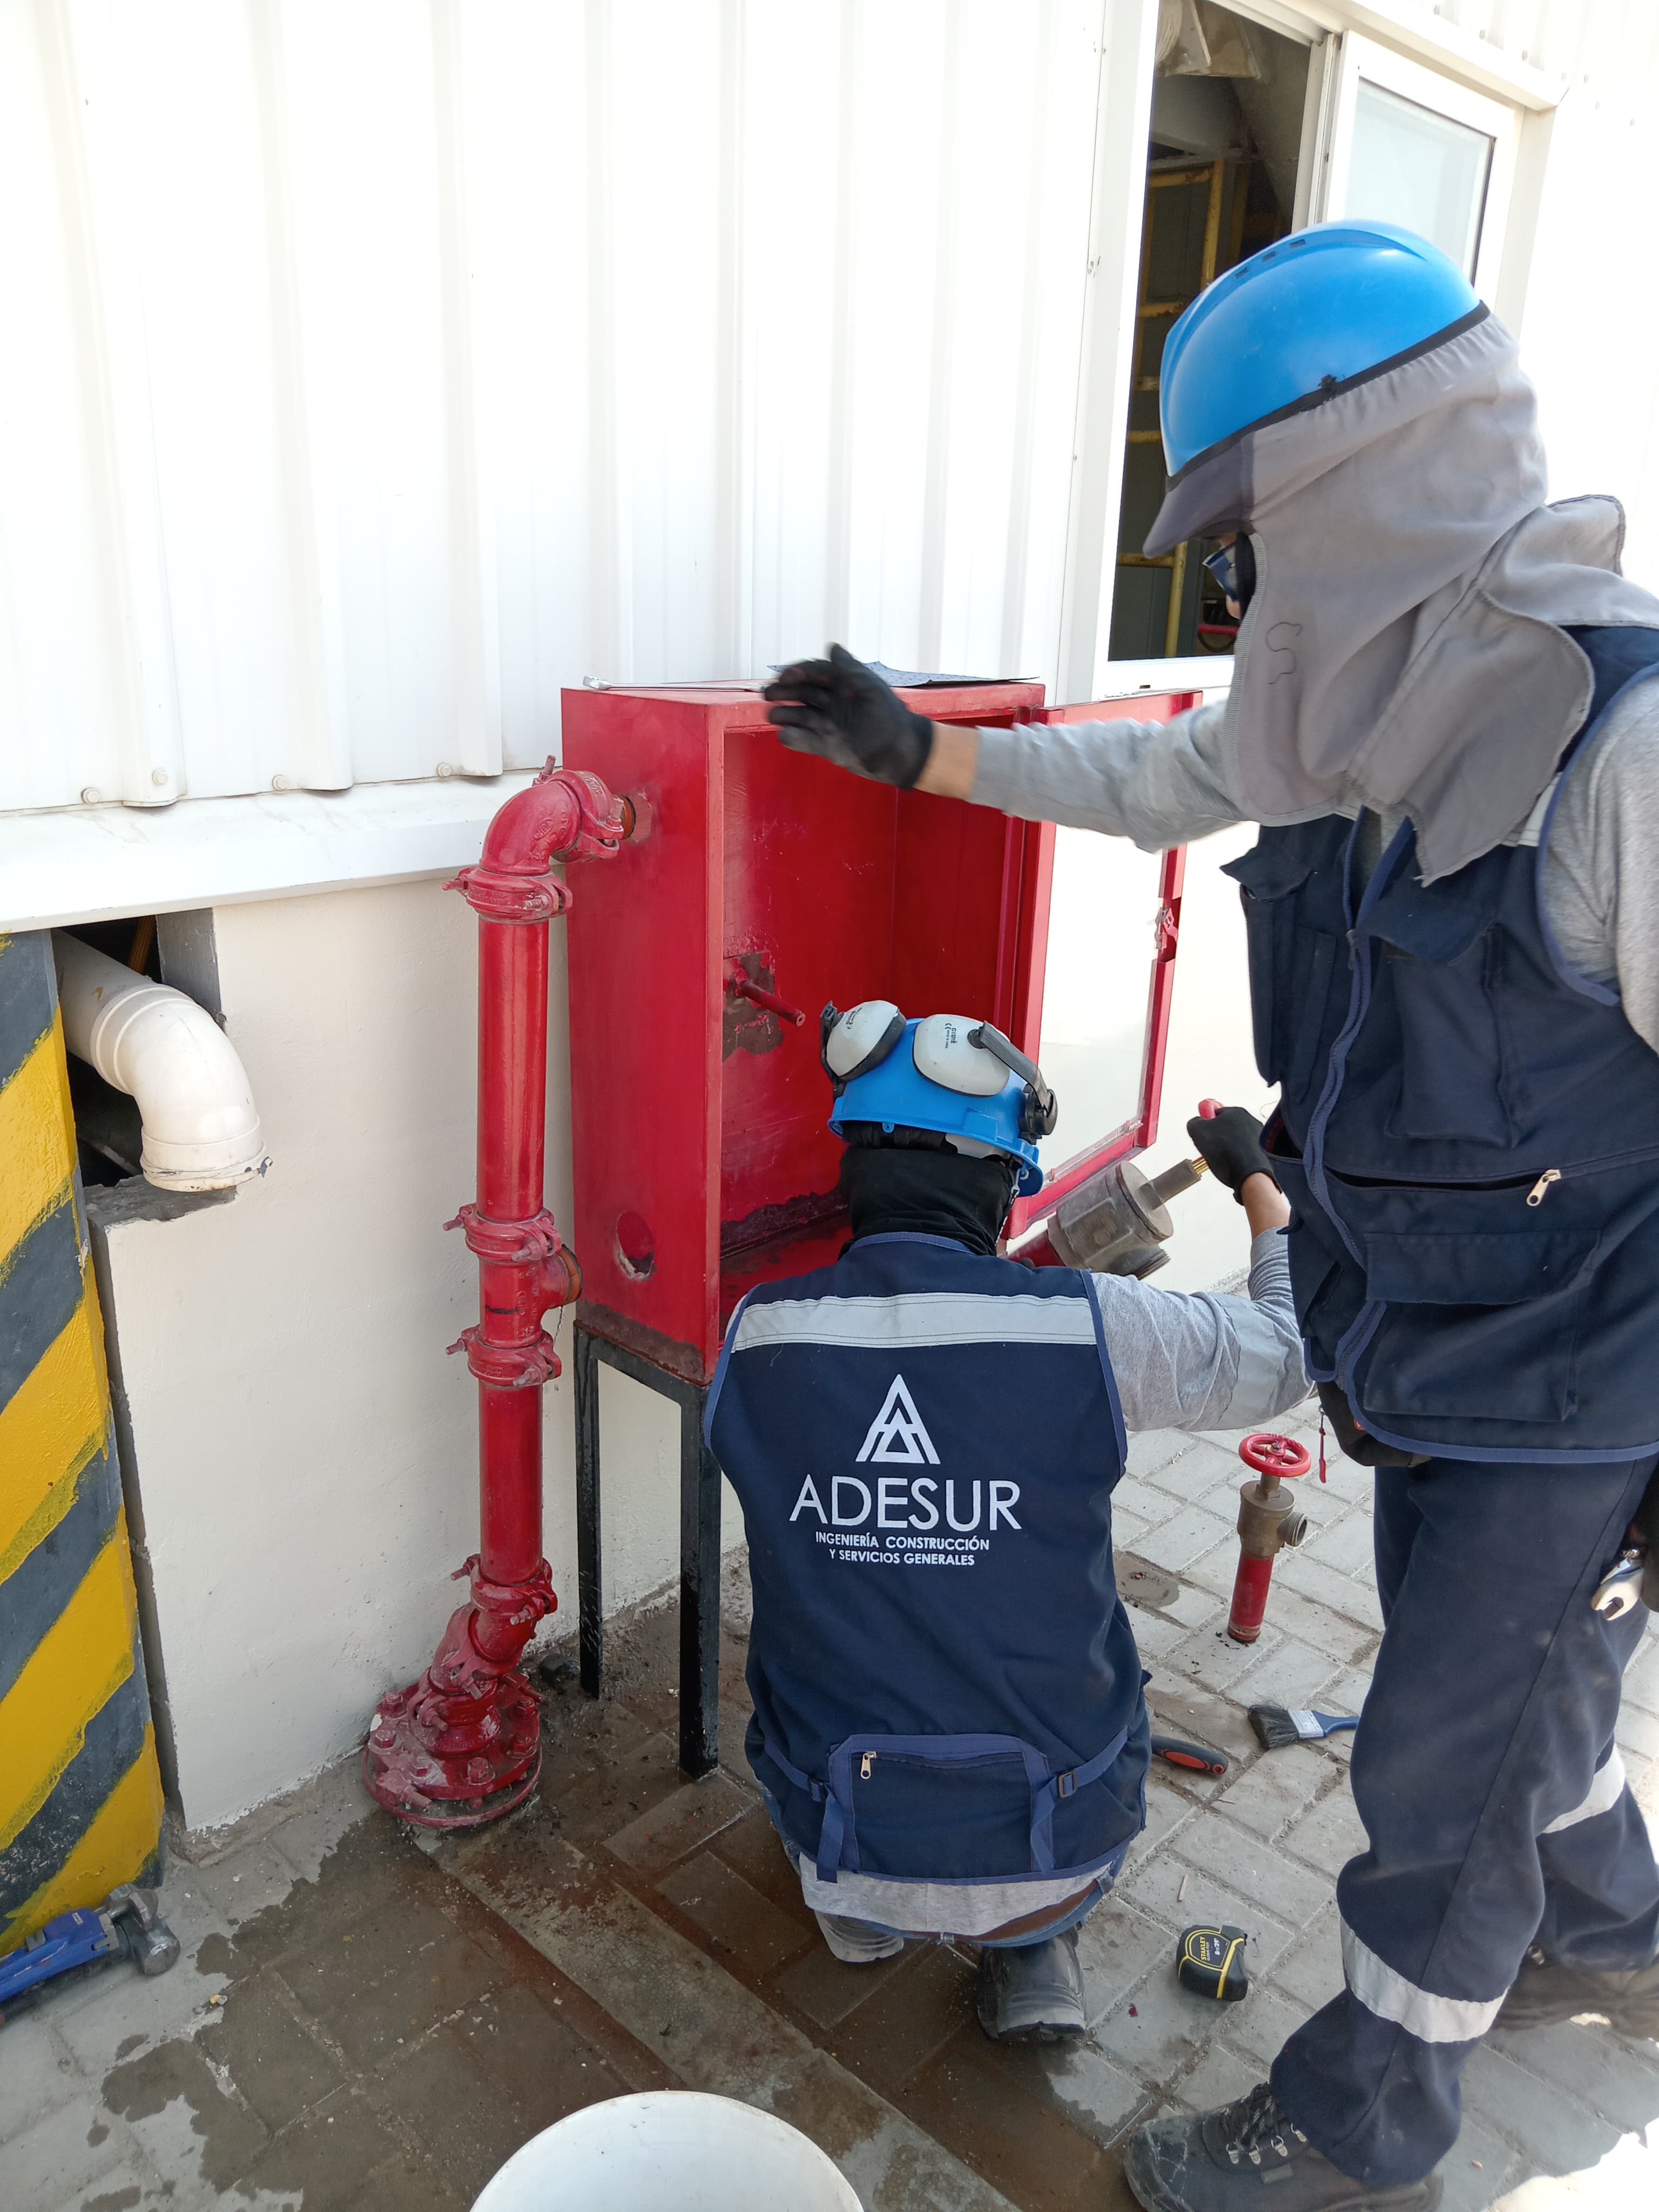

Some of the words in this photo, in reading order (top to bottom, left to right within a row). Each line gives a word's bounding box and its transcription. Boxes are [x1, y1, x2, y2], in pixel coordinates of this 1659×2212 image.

[789, 1474, 1022, 1532] ADESUR
[815, 1531, 879, 1548] INGENIERÍA
[886, 1535, 989, 1551] CONSTRUCCIÓN
[829, 1548, 836, 1559] Y
[839, 1549, 900, 1564] SERVICIOS
[903, 1553, 975, 1566] GENERALES
